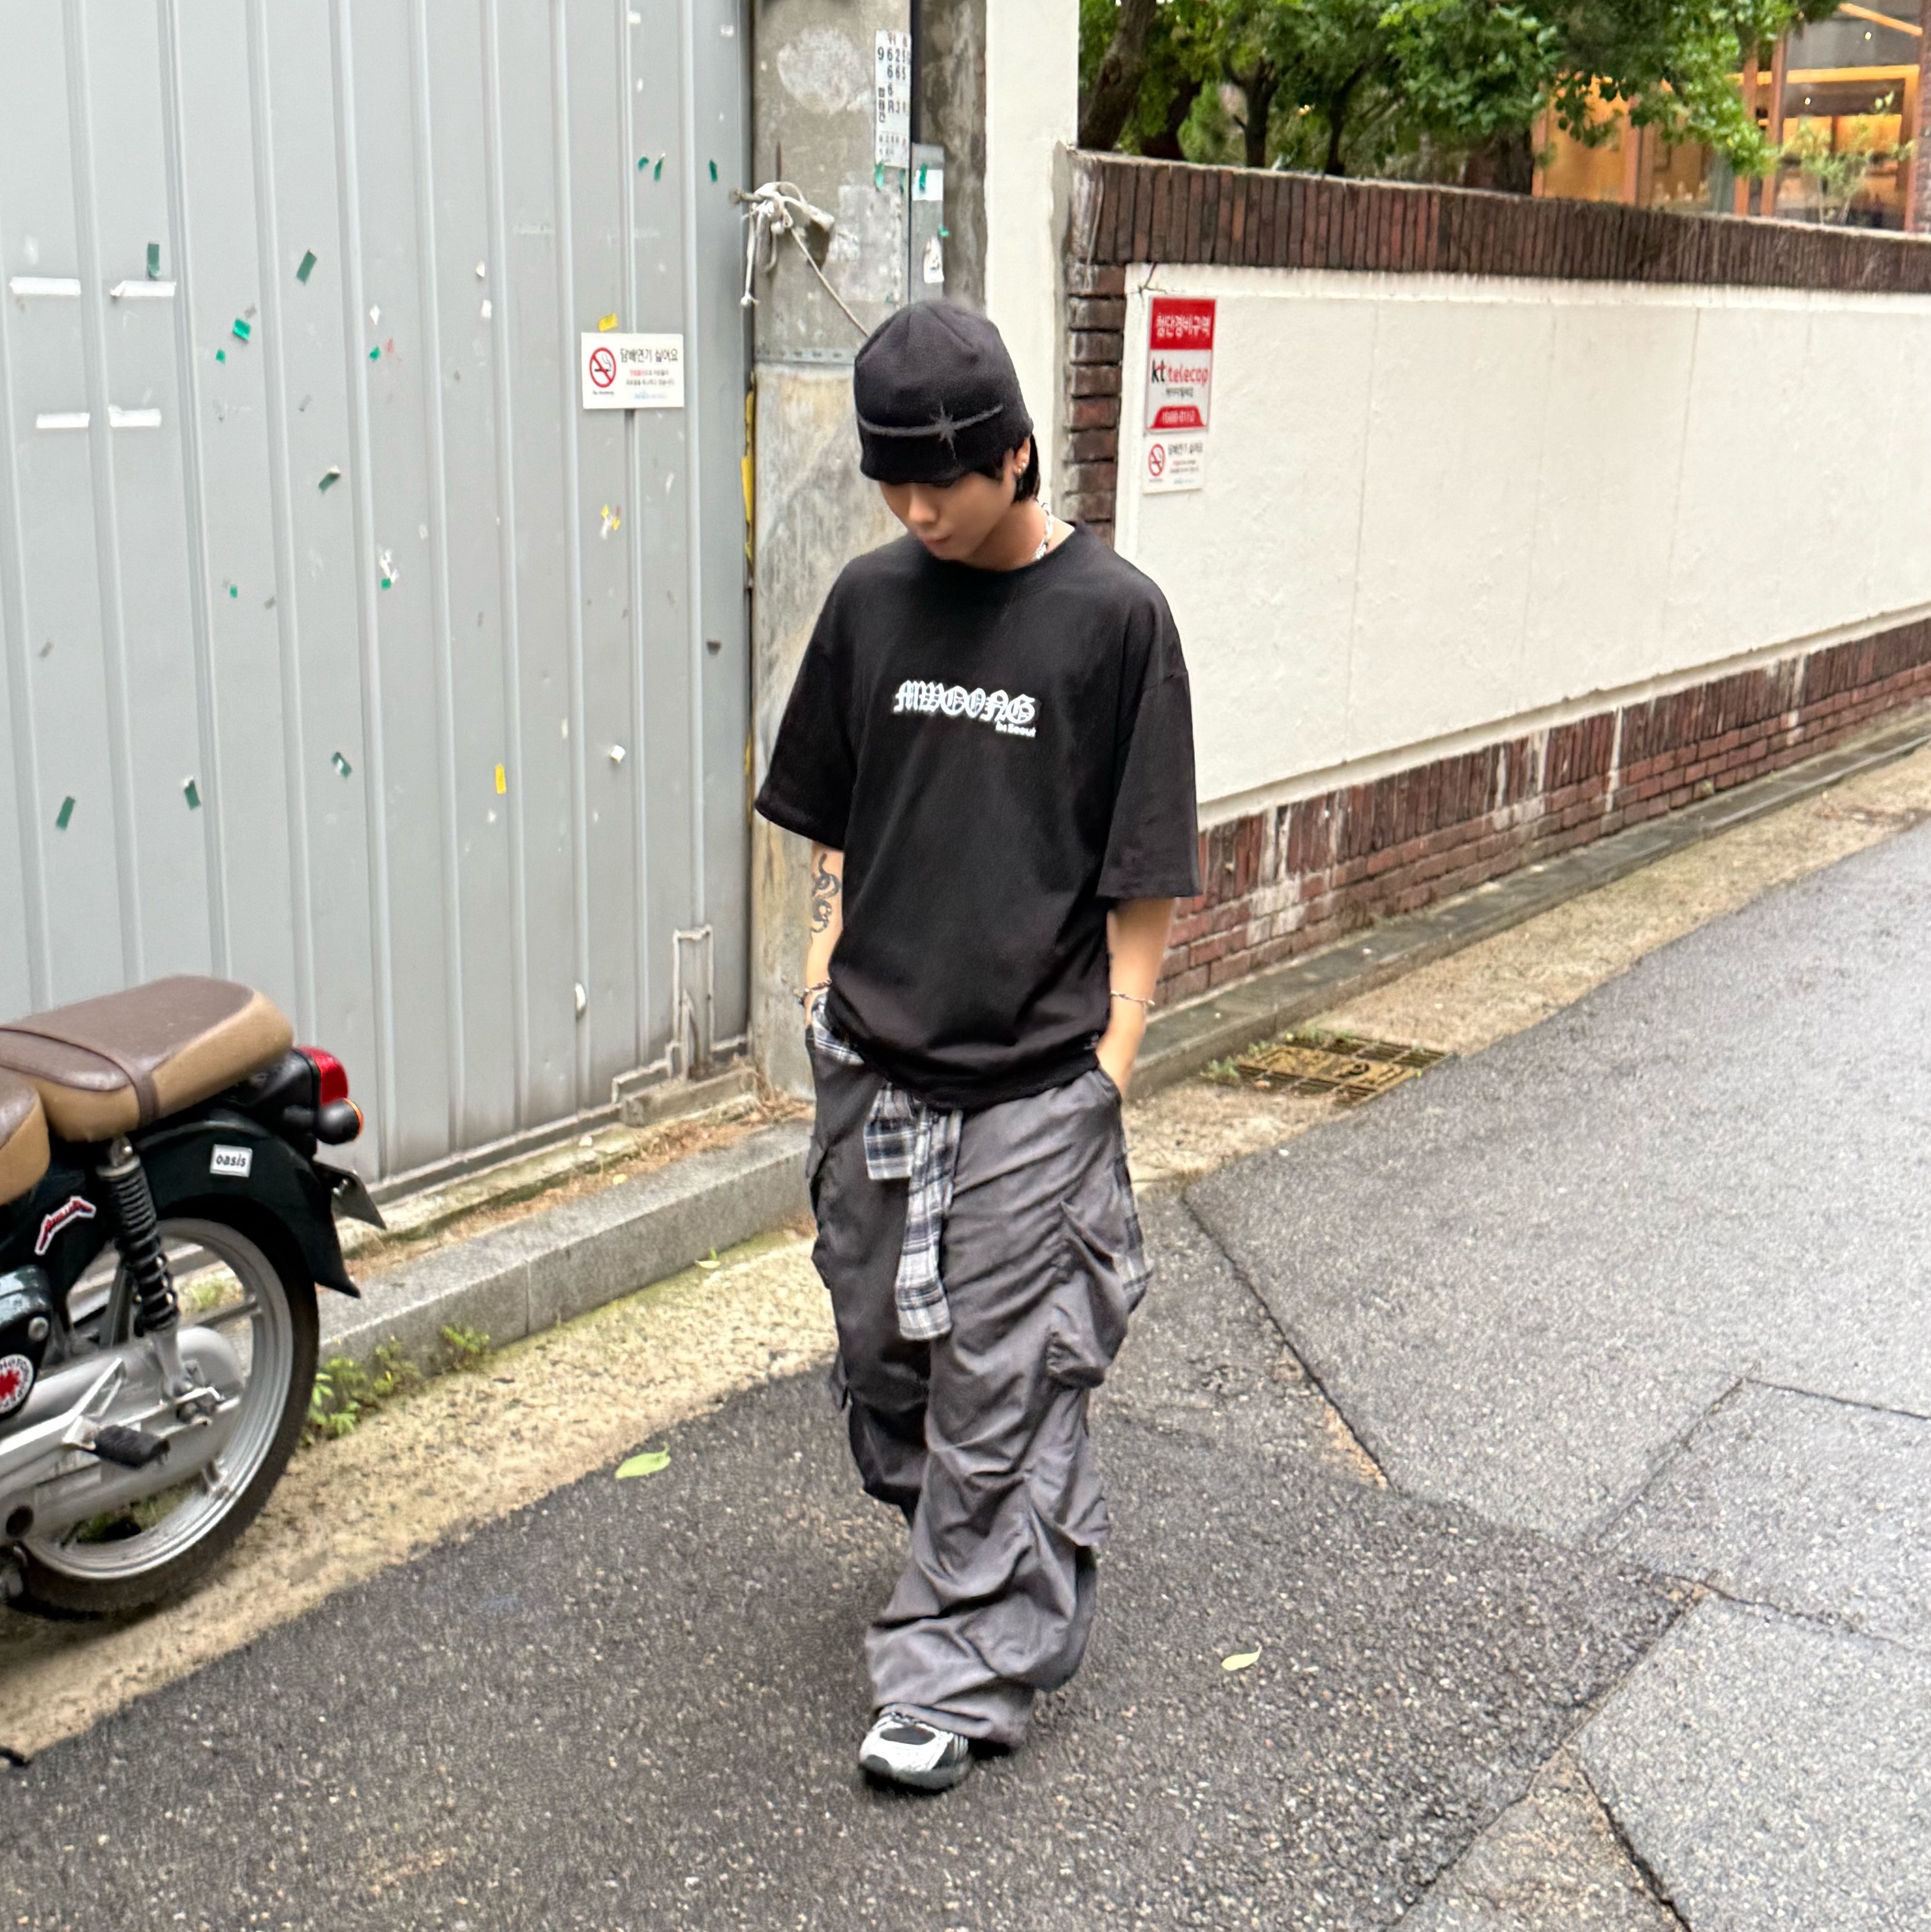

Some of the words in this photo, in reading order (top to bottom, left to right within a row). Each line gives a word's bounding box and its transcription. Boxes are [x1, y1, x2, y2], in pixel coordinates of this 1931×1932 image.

[1156, 314, 1211, 338] 첨단경비구역
[1151, 359, 1165, 382] kt
[1168, 365, 1208, 386] telecop
[216, 1153, 246, 1167] oasis
